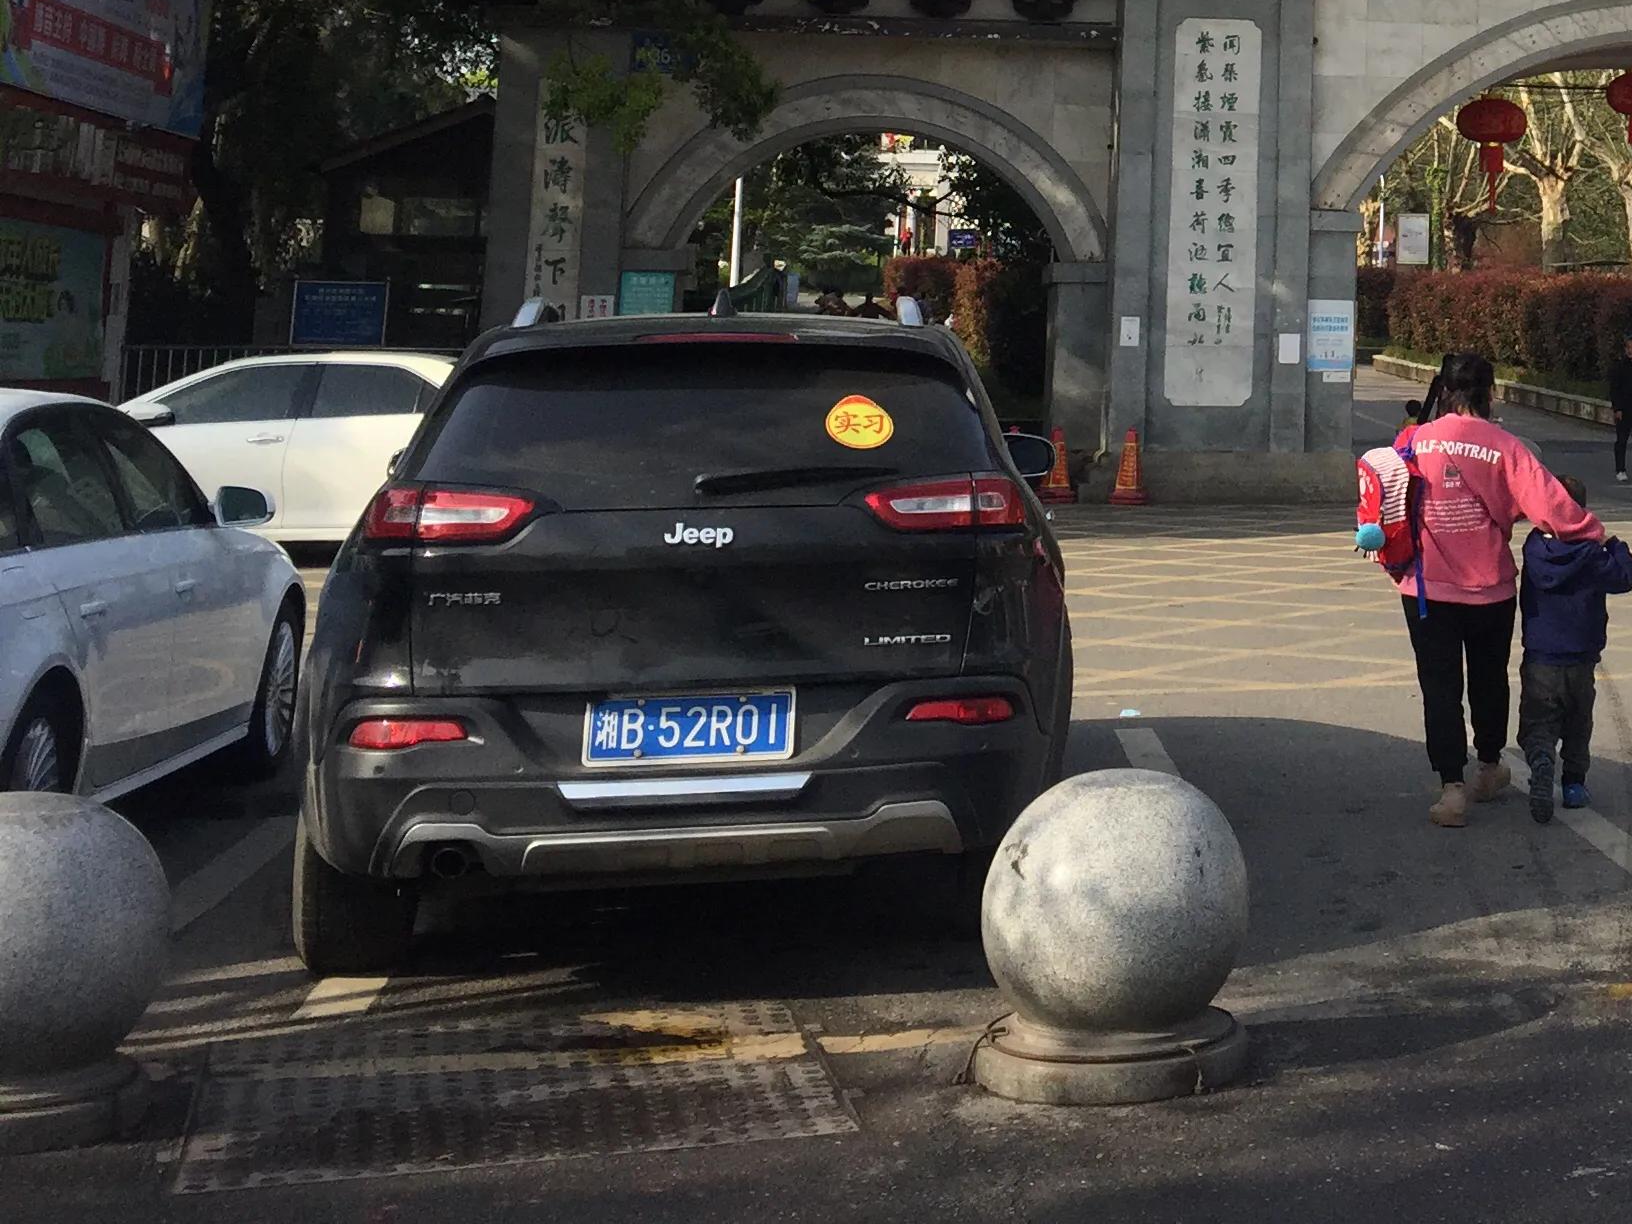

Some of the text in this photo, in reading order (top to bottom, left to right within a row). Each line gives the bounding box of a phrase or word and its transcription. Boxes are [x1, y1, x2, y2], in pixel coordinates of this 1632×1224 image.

[834, 411, 884, 435] 实习
[664, 522, 734, 548] Jeep
[864, 579, 959, 591] CHEROKEE
[428, 591, 501, 607] 广汽菲克
[863, 634, 952, 646] LIMITED
